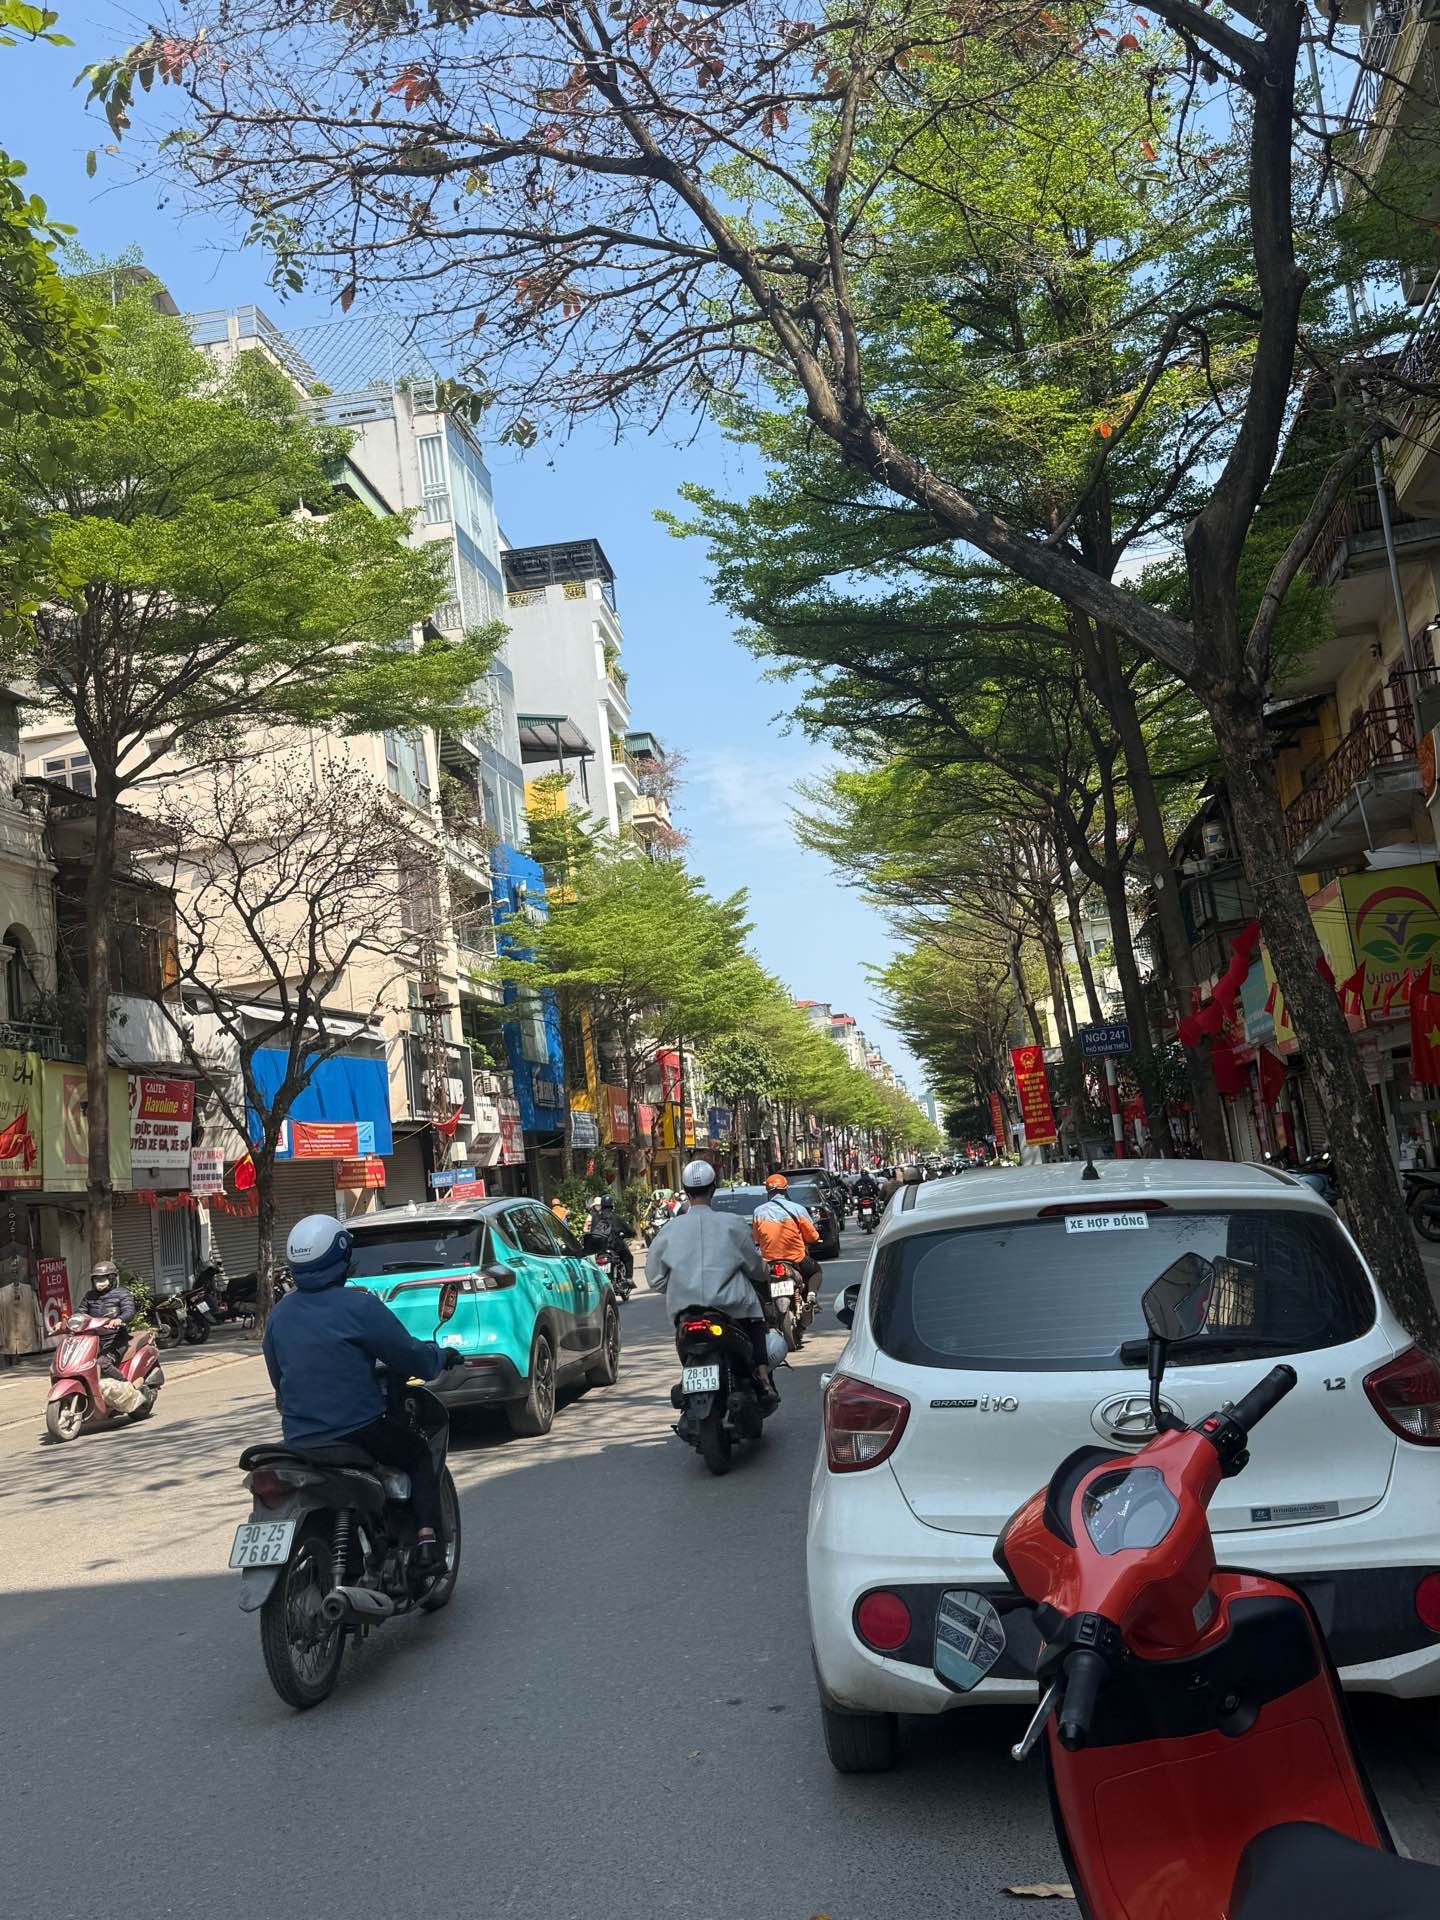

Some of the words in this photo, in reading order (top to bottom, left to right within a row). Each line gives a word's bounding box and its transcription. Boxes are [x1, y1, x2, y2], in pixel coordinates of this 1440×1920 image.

[1109, 1029, 1126, 1041] 241
[145, 1083, 166, 1094] CALTEX
[144, 1096, 179, 1114] Havoline
[153, 1124, 178, 1136] QUANG
[148, 1139, 158, 1150] XE
[171, 1140, 180, 1151] XE
[1070, 1219, 1084, 1229] XE
[1087, 1217, 1110, 1228] HỢP
[47, 1274, 62, 1285] LEO
[685, 1377, 717, 1393] 115.19
[980, 1394, 1019, 1412] i10
[242, 1524, 286, 1544] 30-Z5
[237, 1543, 282, 1565] 7682
